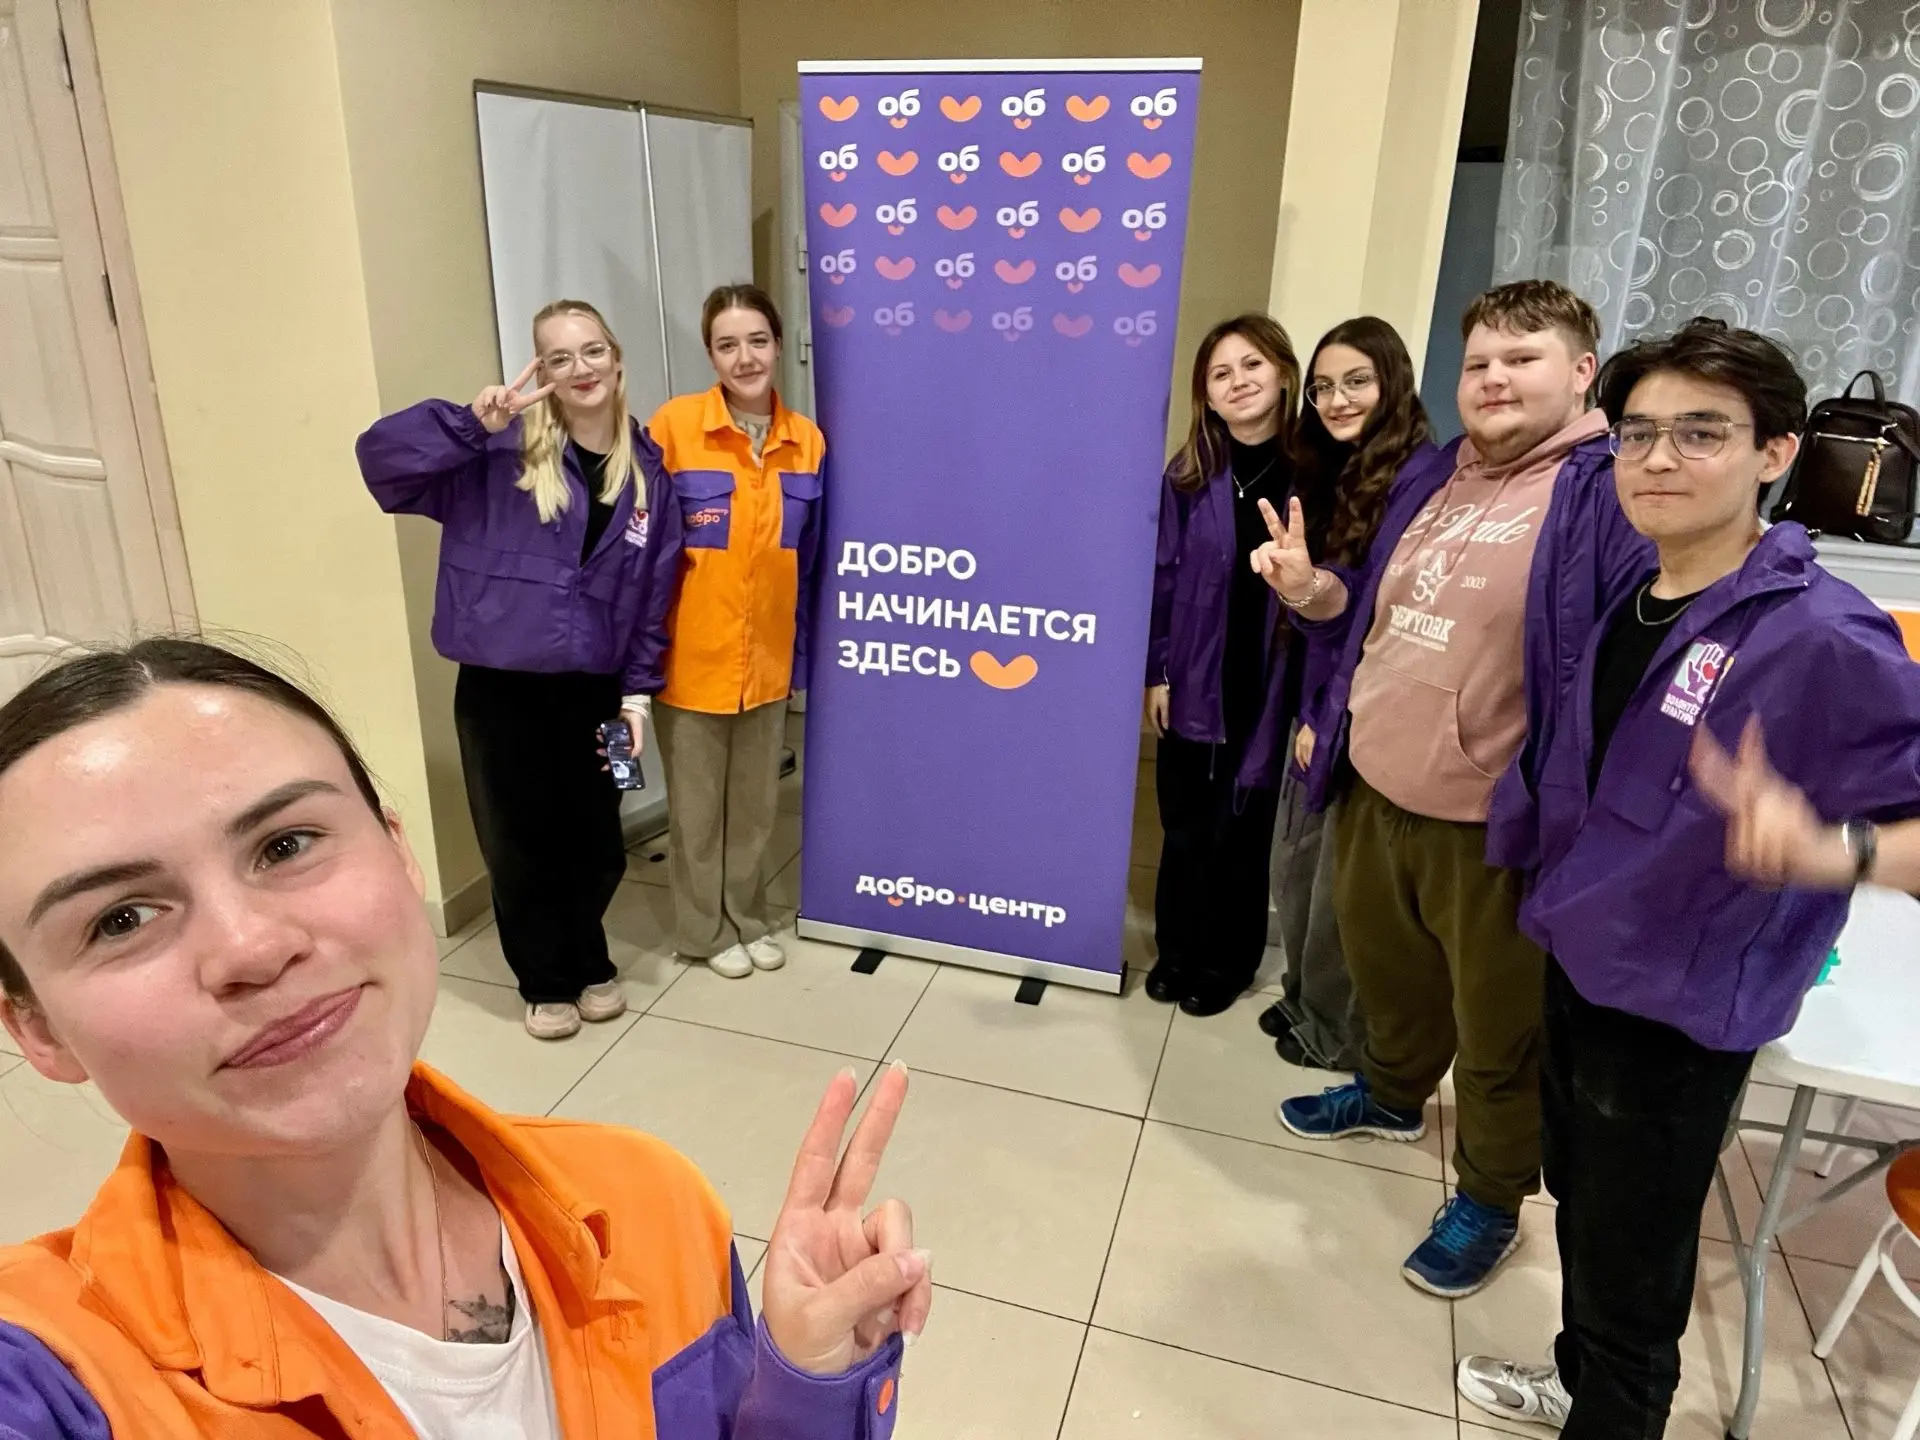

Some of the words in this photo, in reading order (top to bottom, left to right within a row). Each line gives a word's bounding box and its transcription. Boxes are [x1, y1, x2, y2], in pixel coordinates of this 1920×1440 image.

[877, 88, 921, 117] об
[1001, 88, 1046, 117] об
[1130, 87, 1178, 117] об
[819, 143, 859, 170] об
[937, 144, 980, 172] об
[1061, 145, 1106, 173] об
[875, 198, 918, 224] об
[996, 200, 1040, 227] об
[1121, 202, 1167, 229] об
[820, 248, 857, 274] об
[934, 252, 975, 278] об
[1055, 255, 1098, 282] об
[873, 301, 915, 327] об
[991, 306, 1034, 331] об
[1113, 310, 1157, 336] об
[685, 511, 720, 526] обро
[837, 541, 977, 580] ДОБРО
[838, 590, 1097, 644] НАЧИНАЕТСЯ
[837, 640, 961, 678] ЗДЕСЬ
